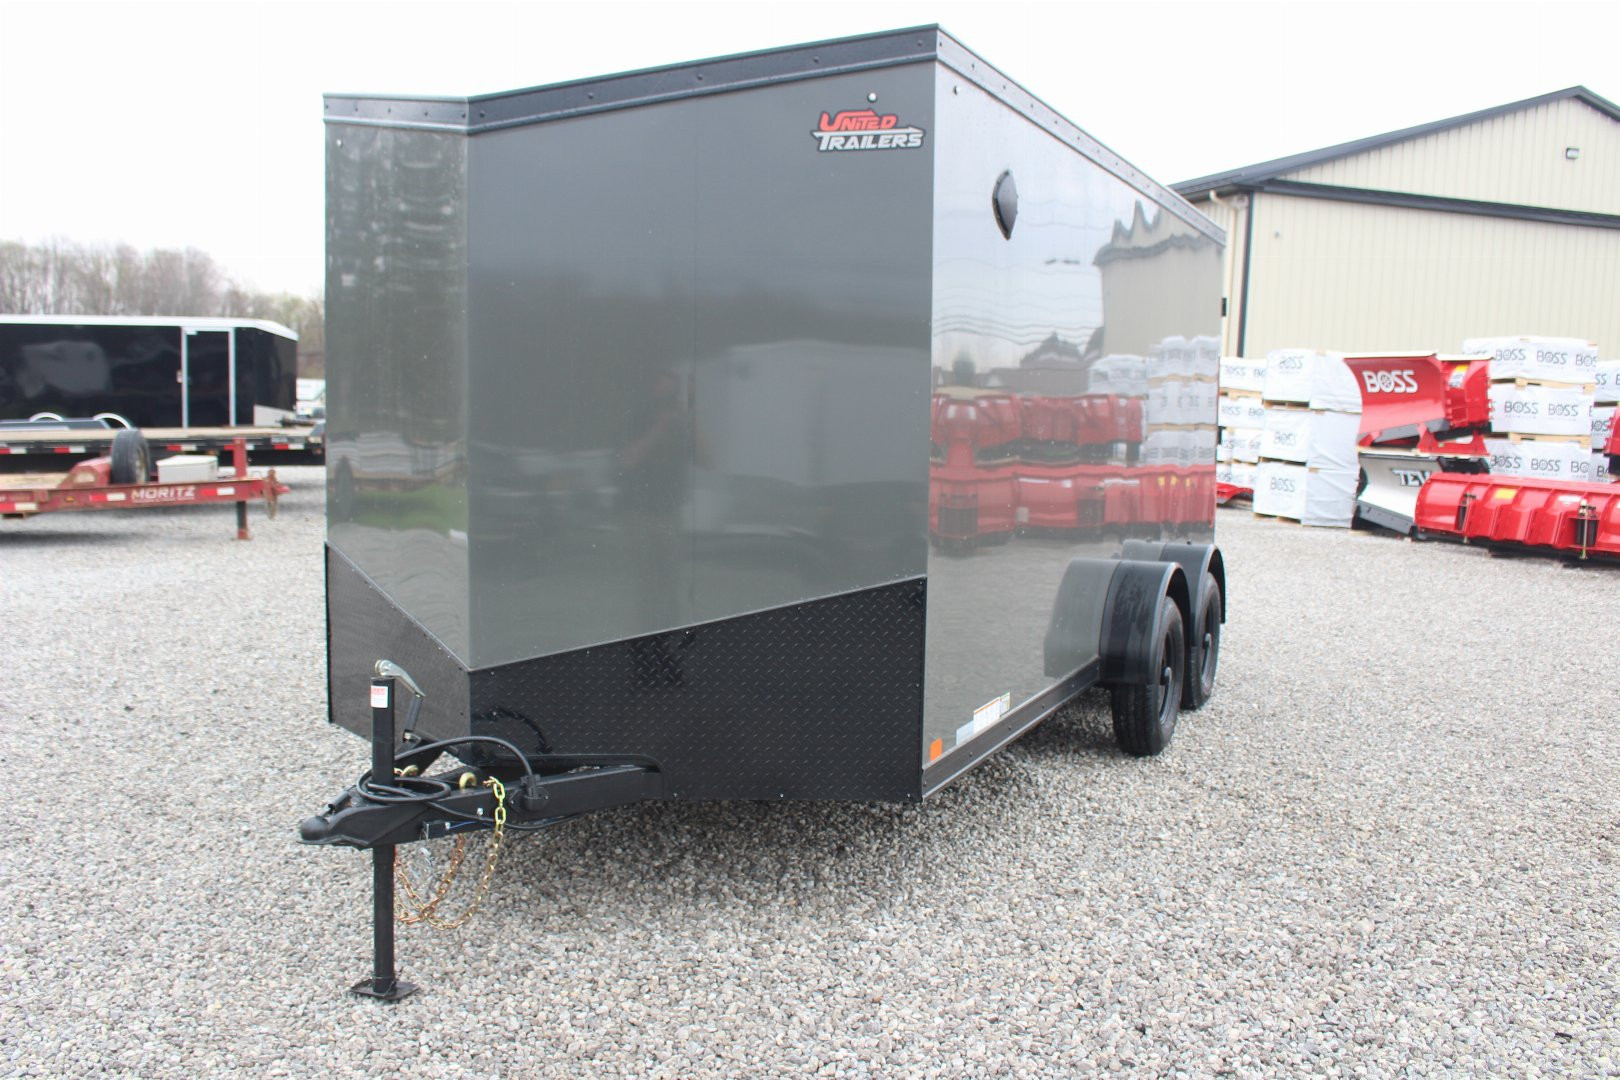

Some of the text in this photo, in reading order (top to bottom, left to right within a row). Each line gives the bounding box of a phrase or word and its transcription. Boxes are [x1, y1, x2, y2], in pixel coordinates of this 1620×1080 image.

[819, 109, 897, 131] UNITED
[811, 126, 925, 151] TRAILERS
[1495, 348, 1526, 361] BOSS
[1536, 350, 1568, 365] BOSS
[1362, 370, 1418, 393] BOSS
[1504, 401, 1538, 415] BOSS
[1548, 403, 1578, 417] BOSS
[1490, 454, 1522, 469] BOSS
[1531, 458, 1561, 472] BOSS
[1270, 477, 1296, 492] BOSS
[131, 486, 195, 500] MORITZ
